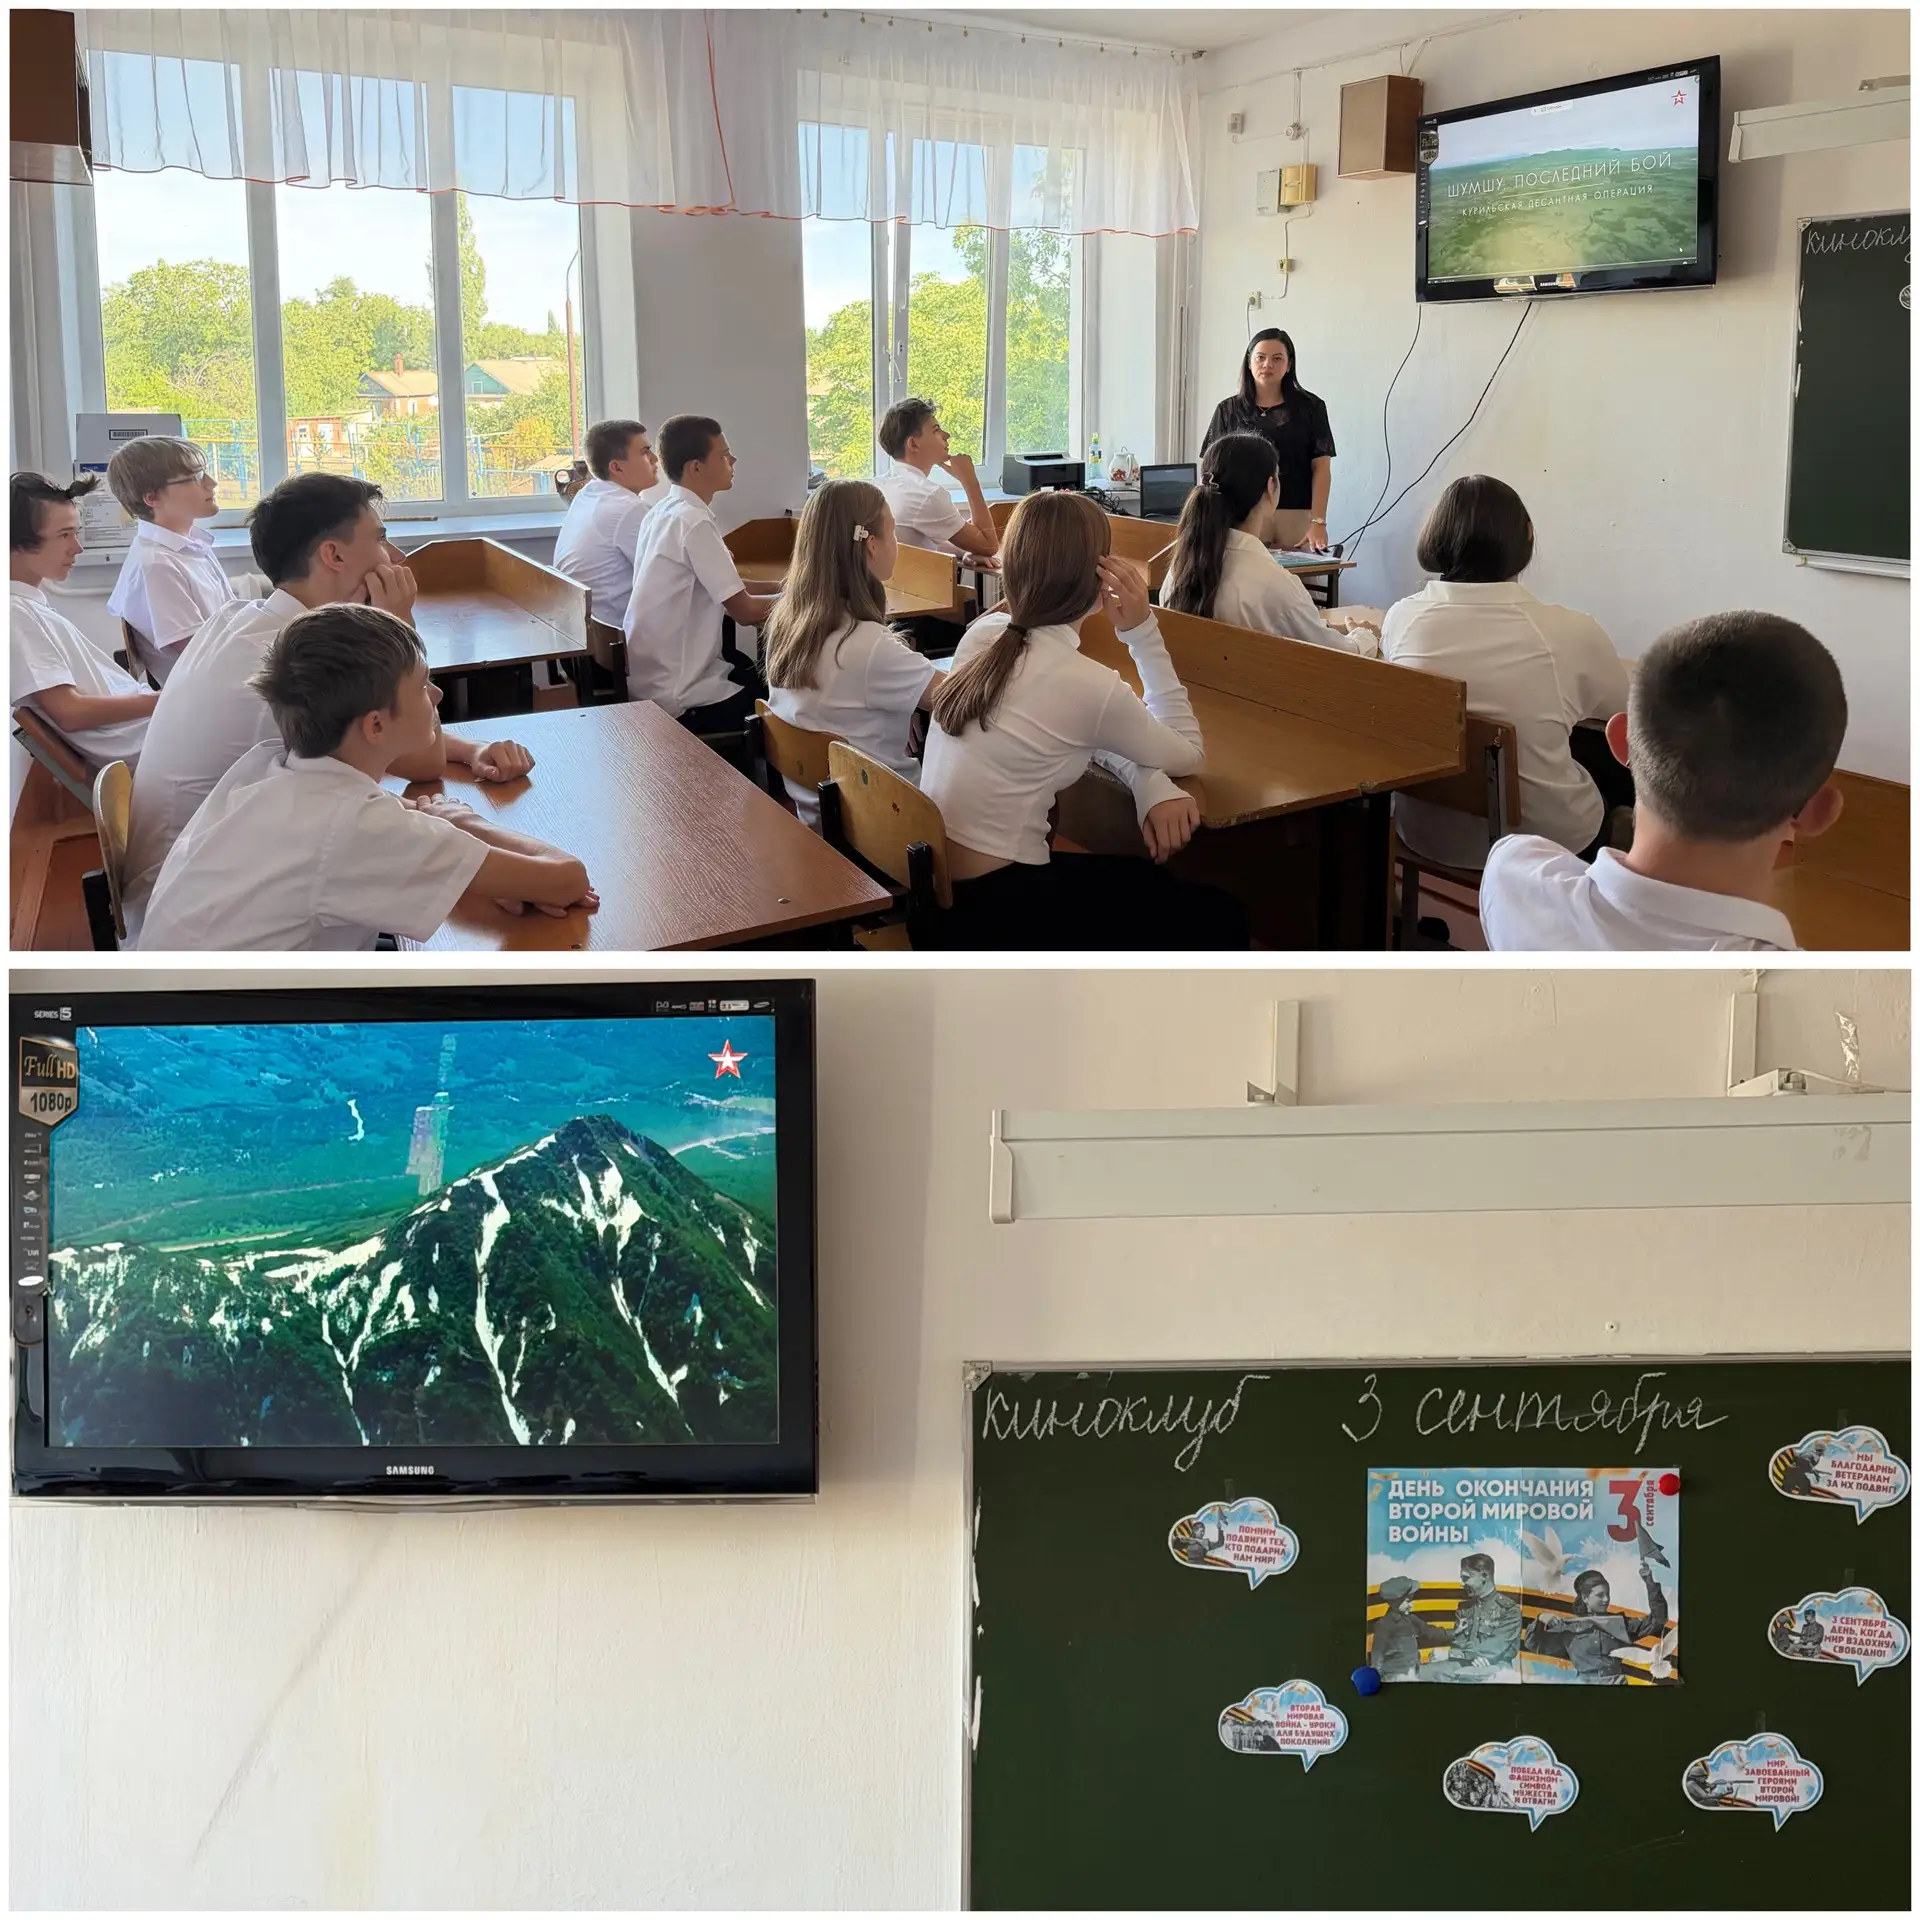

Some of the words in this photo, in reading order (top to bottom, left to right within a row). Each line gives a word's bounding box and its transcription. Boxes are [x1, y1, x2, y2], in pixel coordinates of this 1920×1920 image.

[1515, 158, 1620, 188] ПОСЛЕДНИЙ
[1631, 151, 1671, 172] БОЙ
[1462, 201, 1523, 216] КУРИЛЬСКАЯ
[1528, 192, 1588, 208] ДЕСАНТНАЯ
[1593, 184, 1653, 200] ОПЕРАЦИЯ
[34, 1009, 59, 1019] SERIES
[24, 1053, 58, 1078] Full
[56, 1060, 76, 1079] HD
[30, 1092, 72, 1113] 1080p
[1341, 1373, 1383, 1442] 3
[1415, 1371, 1730, 1455] сентября
[1857, 1453, 1873, 1462] МЫ
[386, 1465, 434, 1476] SAMSUNG
[1831, 1460, 1897, 1475] БЛАГОДАРНЫ
[1835, 1470, 1890, 1484] ВЕТЕРАНАМ
[1388, 1479, 1445, 1500] ДЕНЬ
[1456, 1479, 1594, 1498] ОКОНЧАНИЯ
[1826, 1479, 1839, 1488] ЗА
[1841, 1480, 1854, 1489] ИХ
[1856, 1481, 1897, 1494] ПОДВИГ!
[1643, 1479, 1656, 1527] сентября
[1388, 1499, 1476, 1521] ВТОРОЙ
[1482, 1500, 1594, 1520] МИРОВОЙ
[1607, 1480, 1643, 1543] 3
[1239, 1525, 1276, 1537] ПОМНИМ
[1388, 1521, 1469, 1543] ВОЙНЫ
[1226, 1533, 1268, 1545] ПОДВИГИ
[1224, 1543, 1242, 1552] КТО
[1244, 1545, 1286, 1556] ПОДАРИЛ
[1233, 1553, 1253, 1563] НАМ
[1254, 1555, 1276, 1564] МИР!
[1832, 1615, 1838, 1623] 3
[1840, 1616, 1887, 1628] СЕНТЯБРЯ
[1830, 1626, 1858, 1636] ДЕНЬ,
[1860, 1628, 1892, 1639] КОГДА
[1824, 1635, 1844, 1643] МИР
[1846, 1637, 1896, 1649] ВЗДОХНУЛ
[1833, 1645, 1886, 1658] СВОБОДНО!
[1290, 1704, 1321, 1712] ВТОРАЯ
[1275, 1721, 1302, 1729] ВОЙНА
[1309, 1721, 1336, 1729] УРОКИ
[1294, 1729, 1335, 1738] БУДУЩИХ
[1280, 1737, 1331, 1746] ПОКОЛЕНИЙ!
[1511, 1766, 1543, 1775] ПОБЕДА
[1544, 1768, 1562, 1776] НАД
[1745, 1767, 1810, 1777] ЗАВОЕВАННЫЙ
[1509, 1774, 1558, 1783] ФАШИЗМОМ
[1757, 1777, 1797, 1785] ГЕРОЯМИ
[1519, 1783, 1552, 1791] СИМВОЛ
[1760, 1785, 1794, 1794] ВТОРОЙ
[1513, 1789, 1557, 1798] МУЖЕСТВА
[1755, 1794, 1799, 1803] МИРОВОЙ!
[1522, 1797, 1556, 1806] ОТВАГИ!
